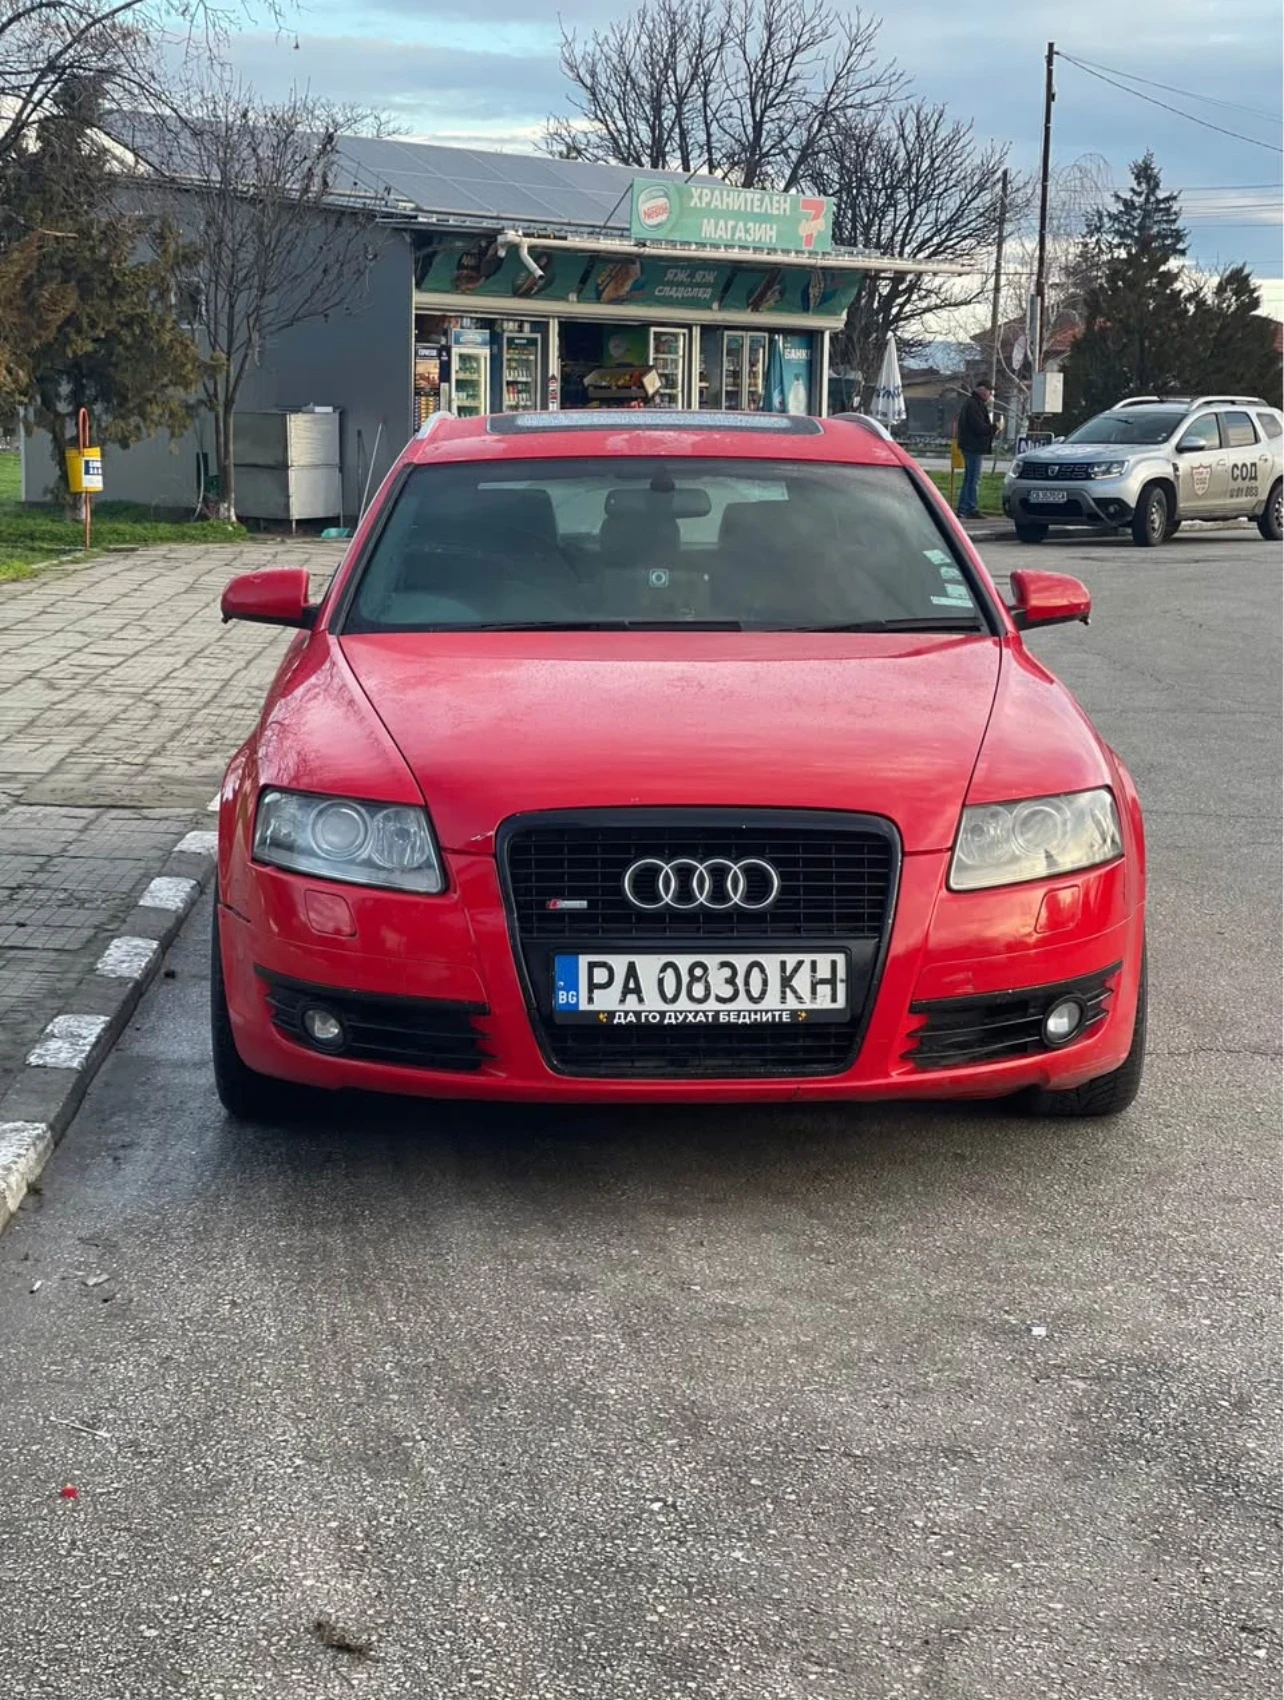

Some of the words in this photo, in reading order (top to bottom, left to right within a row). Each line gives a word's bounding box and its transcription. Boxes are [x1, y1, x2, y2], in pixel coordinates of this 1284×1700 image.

[690, 187, 790, 215] ХРАНИТЕЛЕН
[701, 219, 777, 243] МАГАЗИН
[1231, 462, 1258, 482] СОД
[587, 961, 646, 1005] PA
[657, 960, 769, 1005] 0830
[779, 959, 838, 1004] KH
[559, 990, 577, 1004] BG
[613, 1012, 637, 1024] ДА
[641, 1012, 660, 1023] ГО
[664, 1011, 715, 1024] ДУХАТ
[719, 1011, 791, 1024] БЕДНИТЕ
